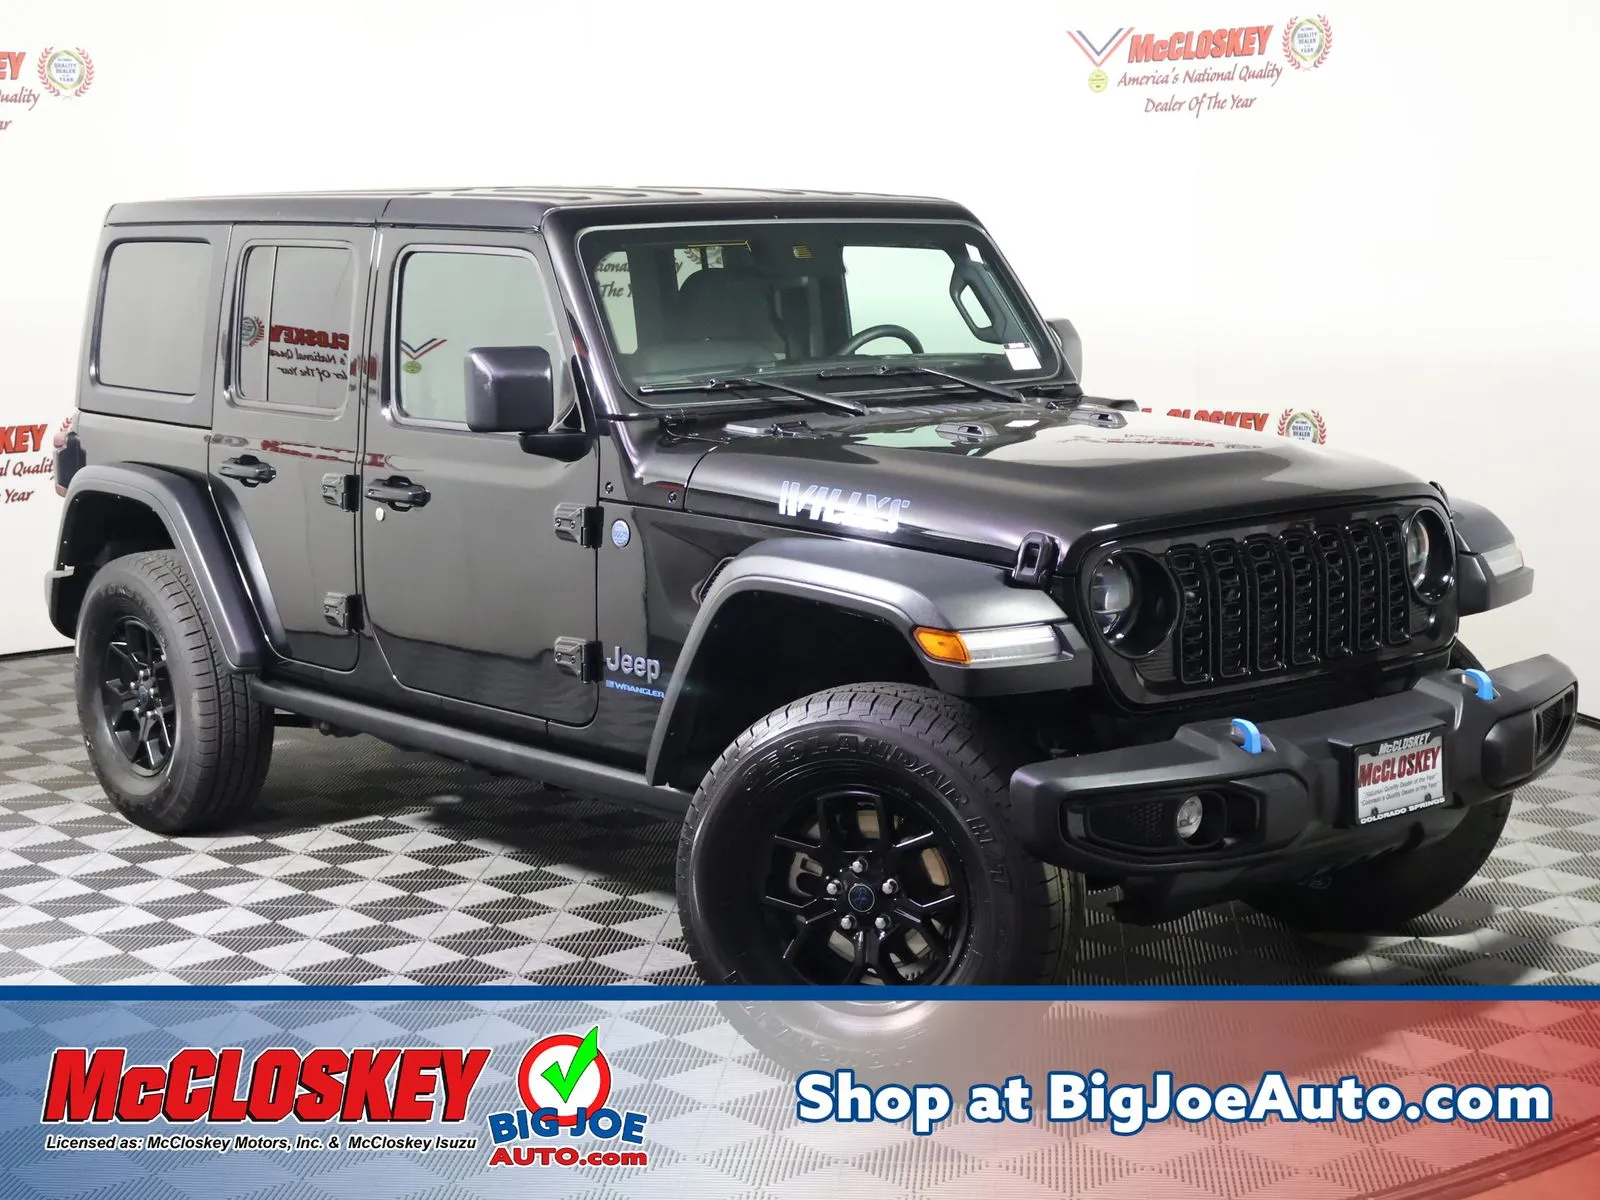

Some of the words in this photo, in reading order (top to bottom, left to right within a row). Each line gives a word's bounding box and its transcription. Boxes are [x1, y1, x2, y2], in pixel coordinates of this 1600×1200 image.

[1128, 25, 1273, 63] McCLOSKEY
[1117, 67, 1179, 87] America's
[1182, 63, 1238, 84] National
[1239, 61, 1283, 87] Quality
[1144, 94, 1186, 113] Dealer
[1188, 93, 1207, 118] Of
[1207, 92, 1227, 110] The
[1231, 94, 1257, 110] Year
[5, 488, 34, 504] Year
[606, 646, 661, 684] Jeep
[614, 681, 665, 699] WRANGLER
[1379, 732, 1431, 755] McCLOSKEY
[1358, 746, 1441, 789] McCLOSKEY
[1360, 807, 1408, 824] COLORADO
[1408, 796, 1446, 812] SPRINGS
